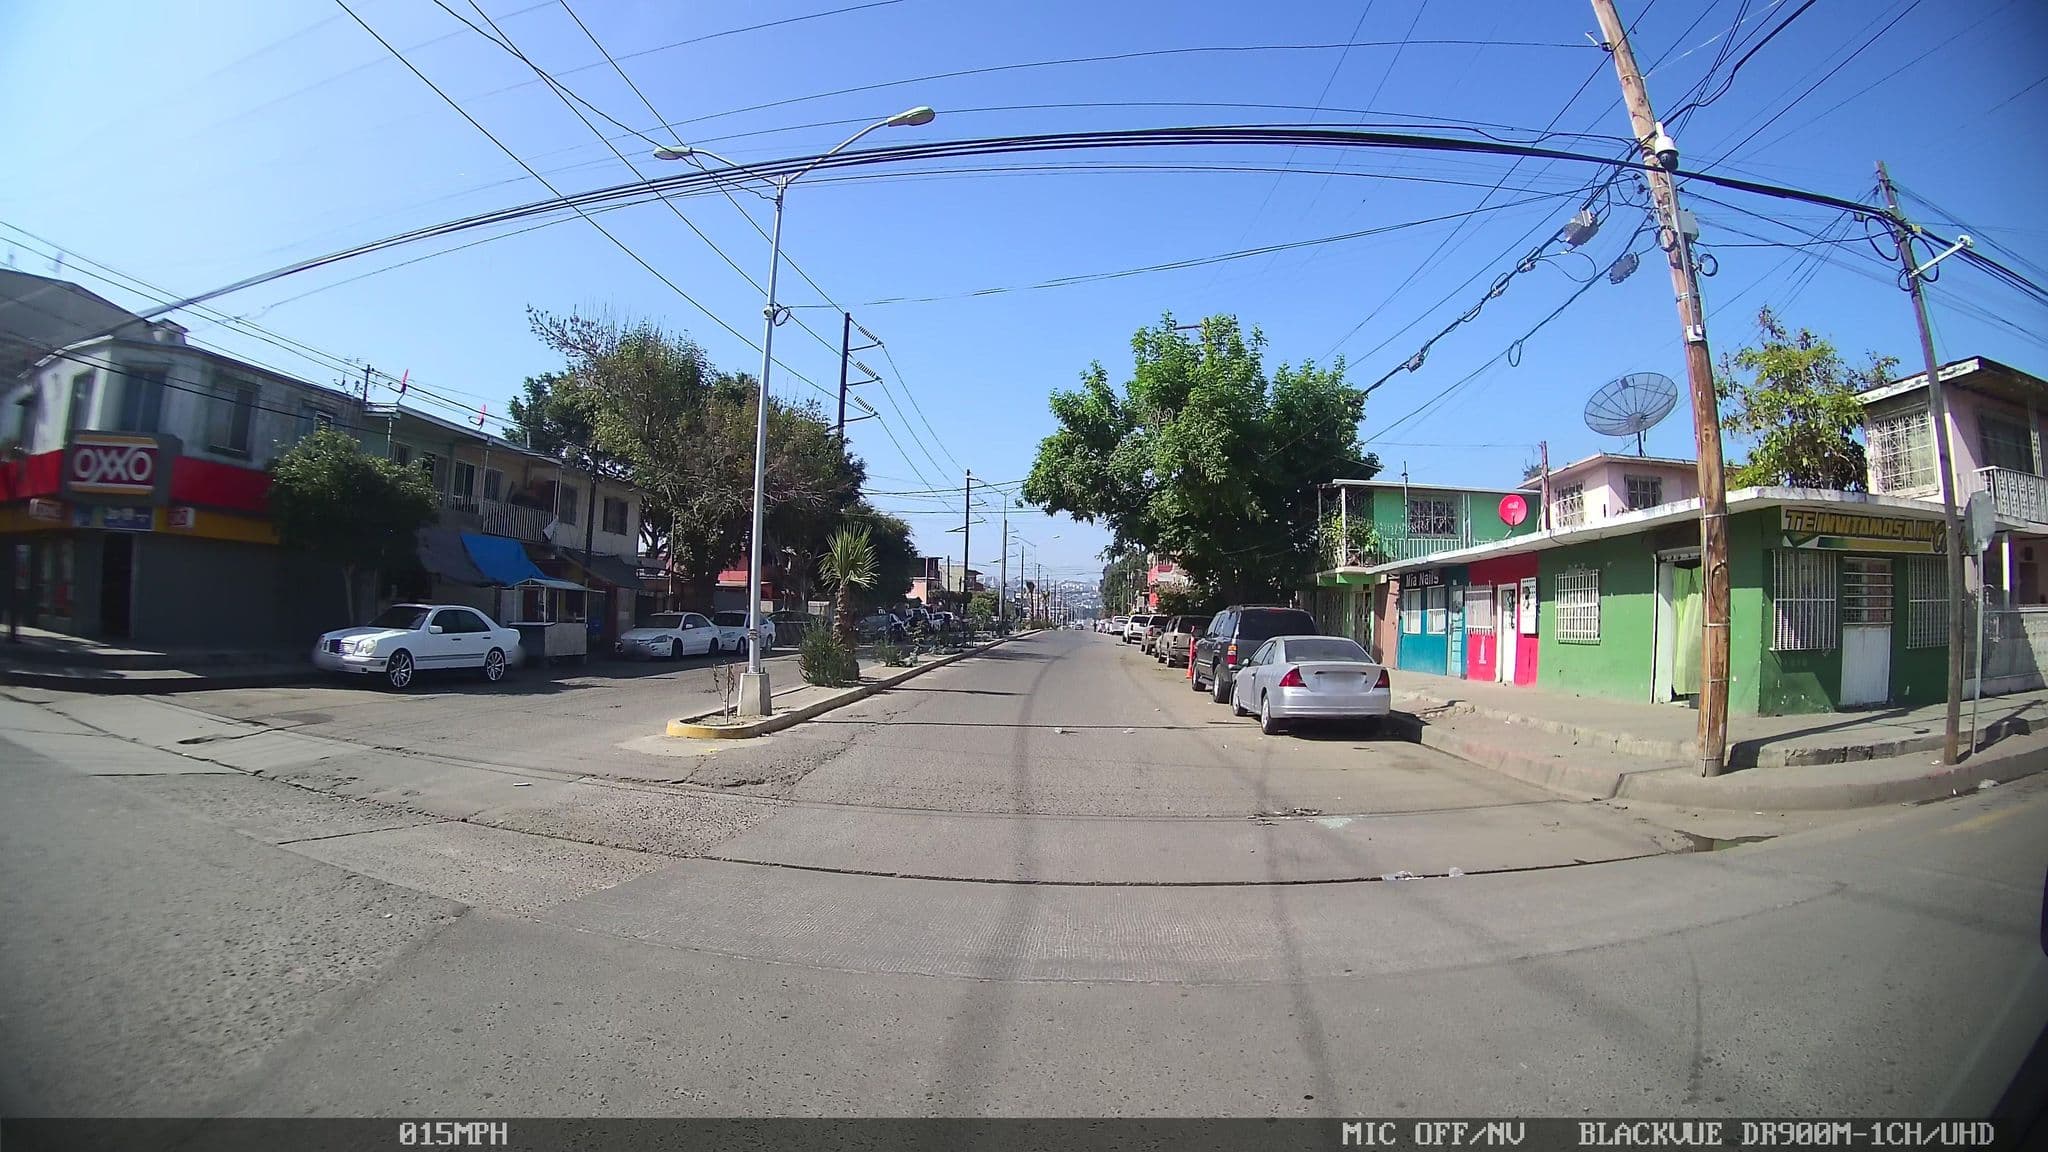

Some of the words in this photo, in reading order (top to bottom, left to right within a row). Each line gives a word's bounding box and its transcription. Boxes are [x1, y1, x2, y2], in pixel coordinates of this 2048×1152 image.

[73, 447, 152, 482] OXXO
[1786, 509, 1815, 532] TE
[1406, 573, 1417, 587] Mia
[1419, 570, 1439, 586] Nails
